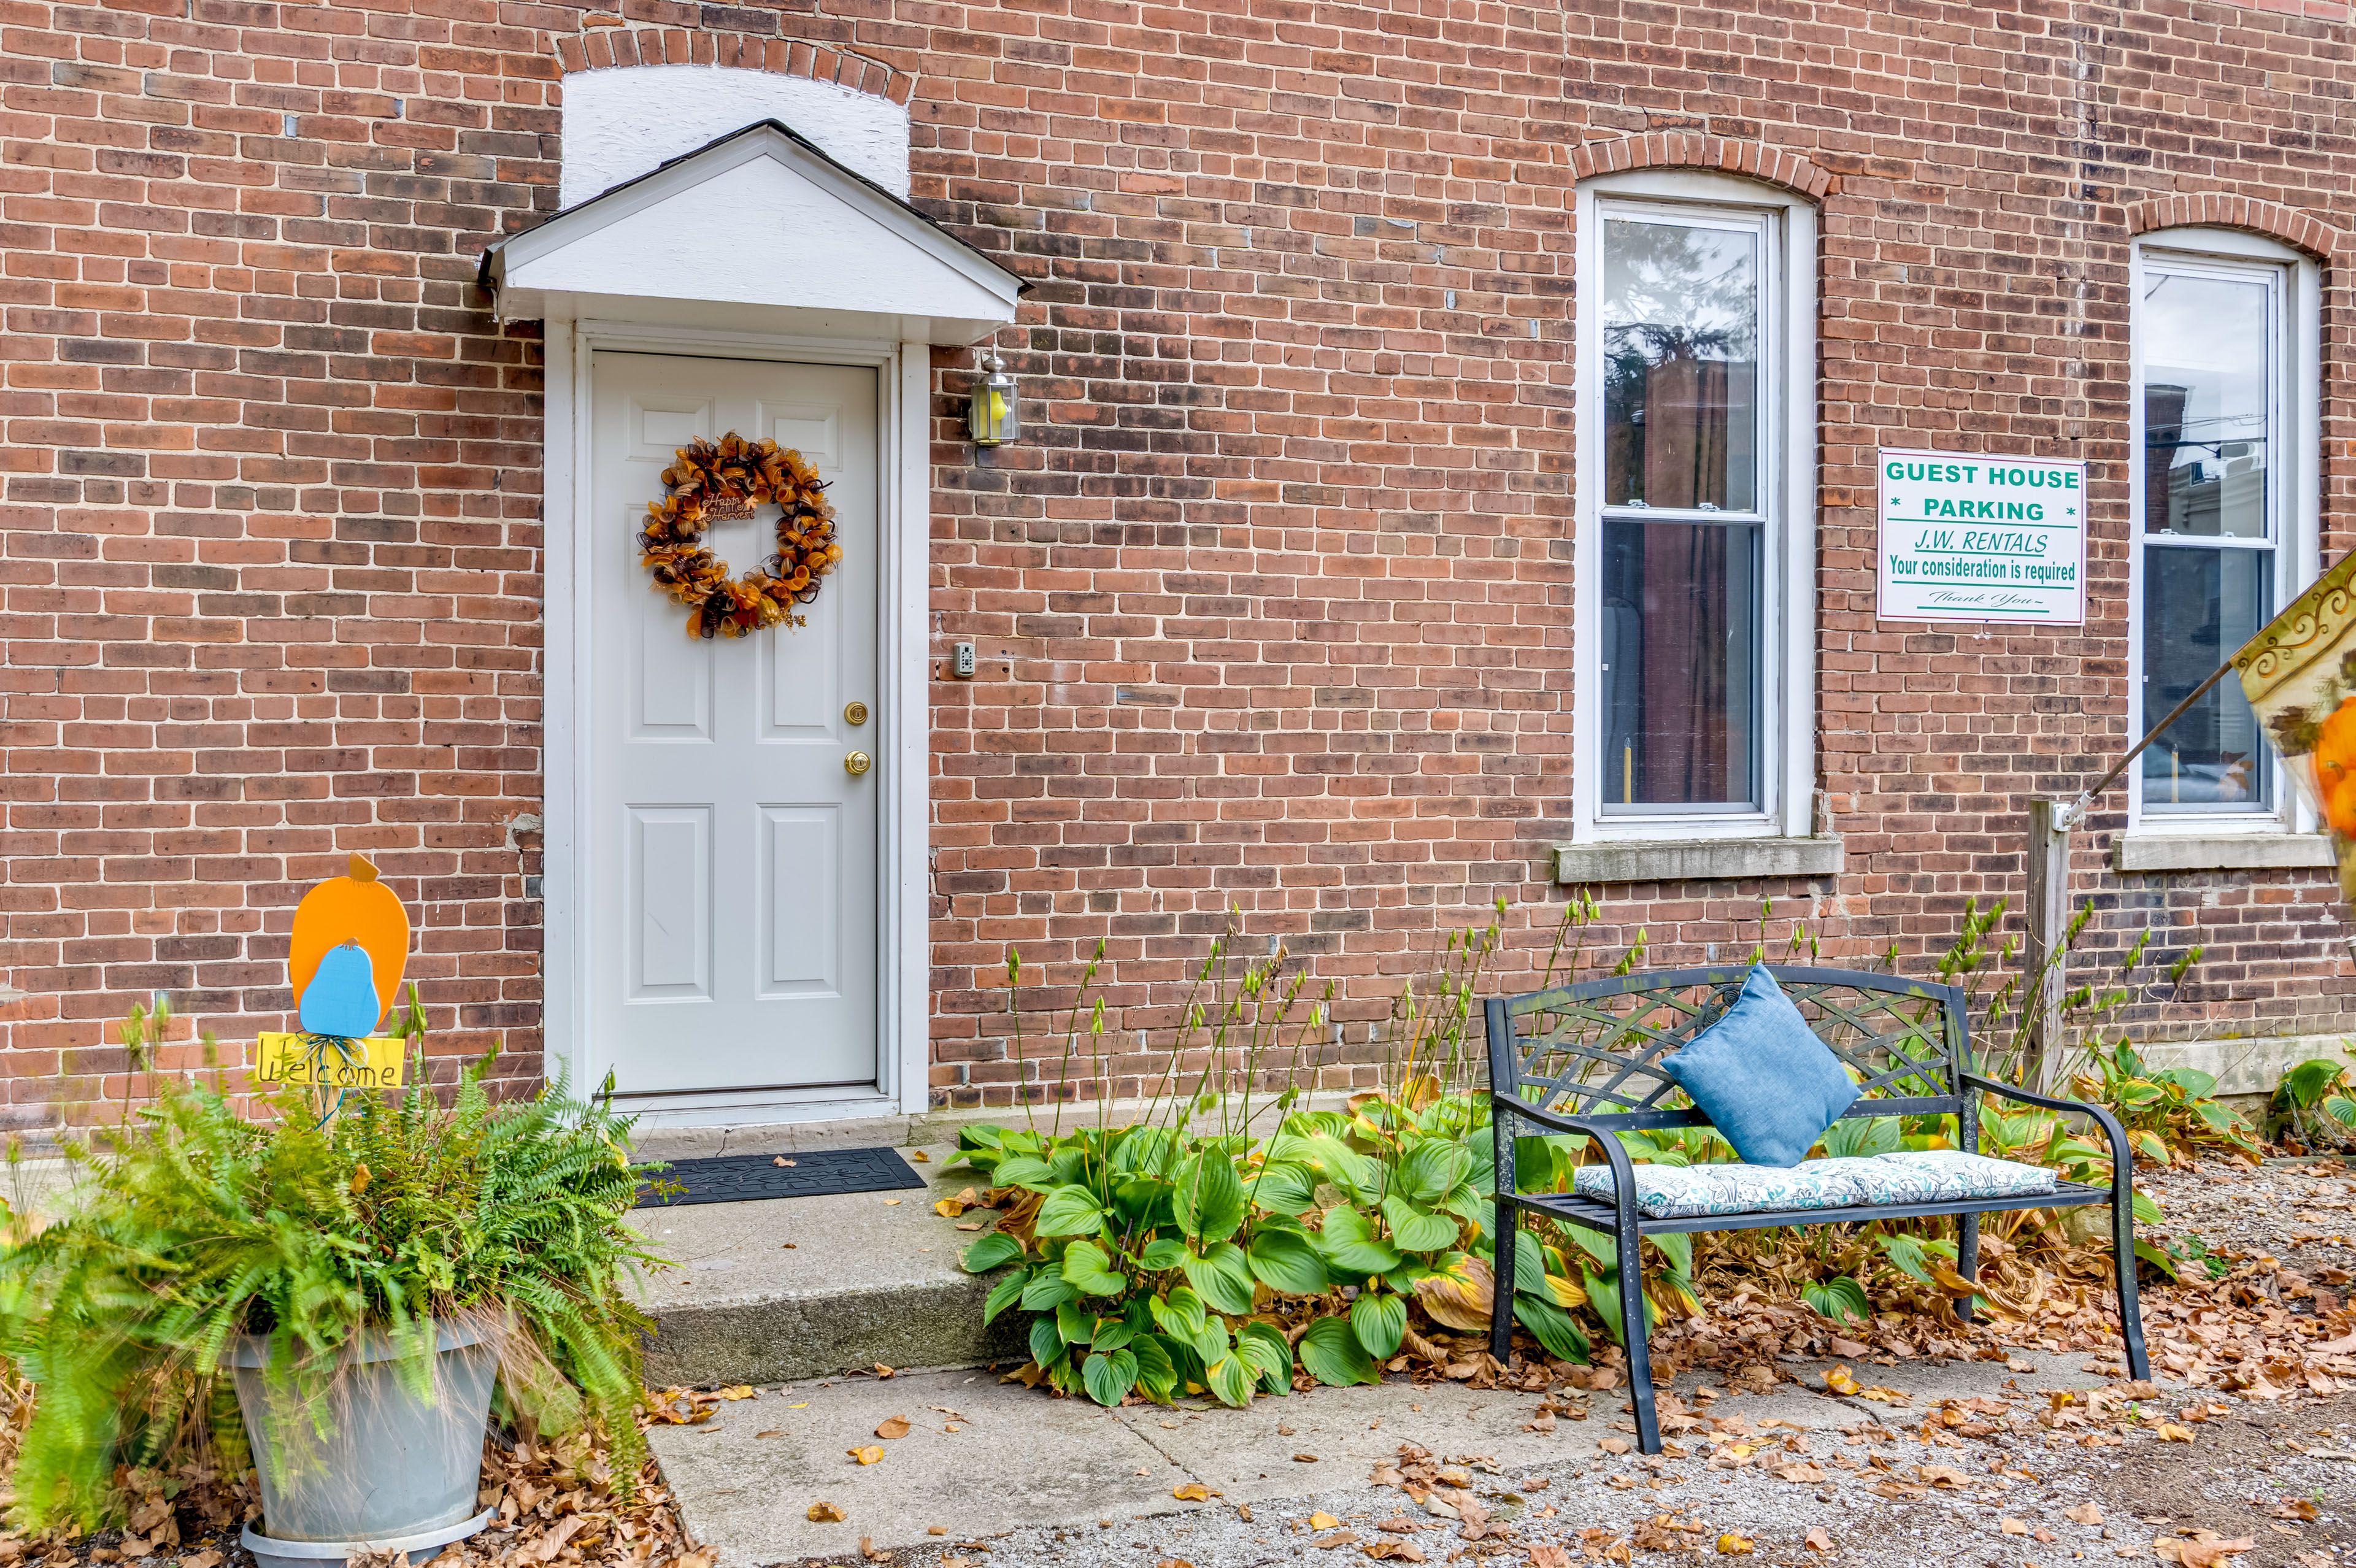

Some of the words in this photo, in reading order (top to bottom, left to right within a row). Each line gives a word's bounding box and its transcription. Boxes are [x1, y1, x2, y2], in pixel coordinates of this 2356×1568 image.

[1886, 462, 1979, 483] GUEST
[1988, 467, 2079, 489] HOUSE
[702, 492, 744, 512] Happy
[1924, 498, 2044, 521] PARKING
[705, 507, 755, 521] Harvest
[1914, 529, 1955, 550] J.W.
[1962, 531, 2048, 553] RENTALS
[1890, 554, 1918, 575] Your
[1922, 557, 2006, 578] consideration
[2011, 559, 2021, 579] is
[2025, 561, 2075, 585] required
[1929, 591, 1986, 604] Thank
[259, 1037, 397, 1086] Welcome
